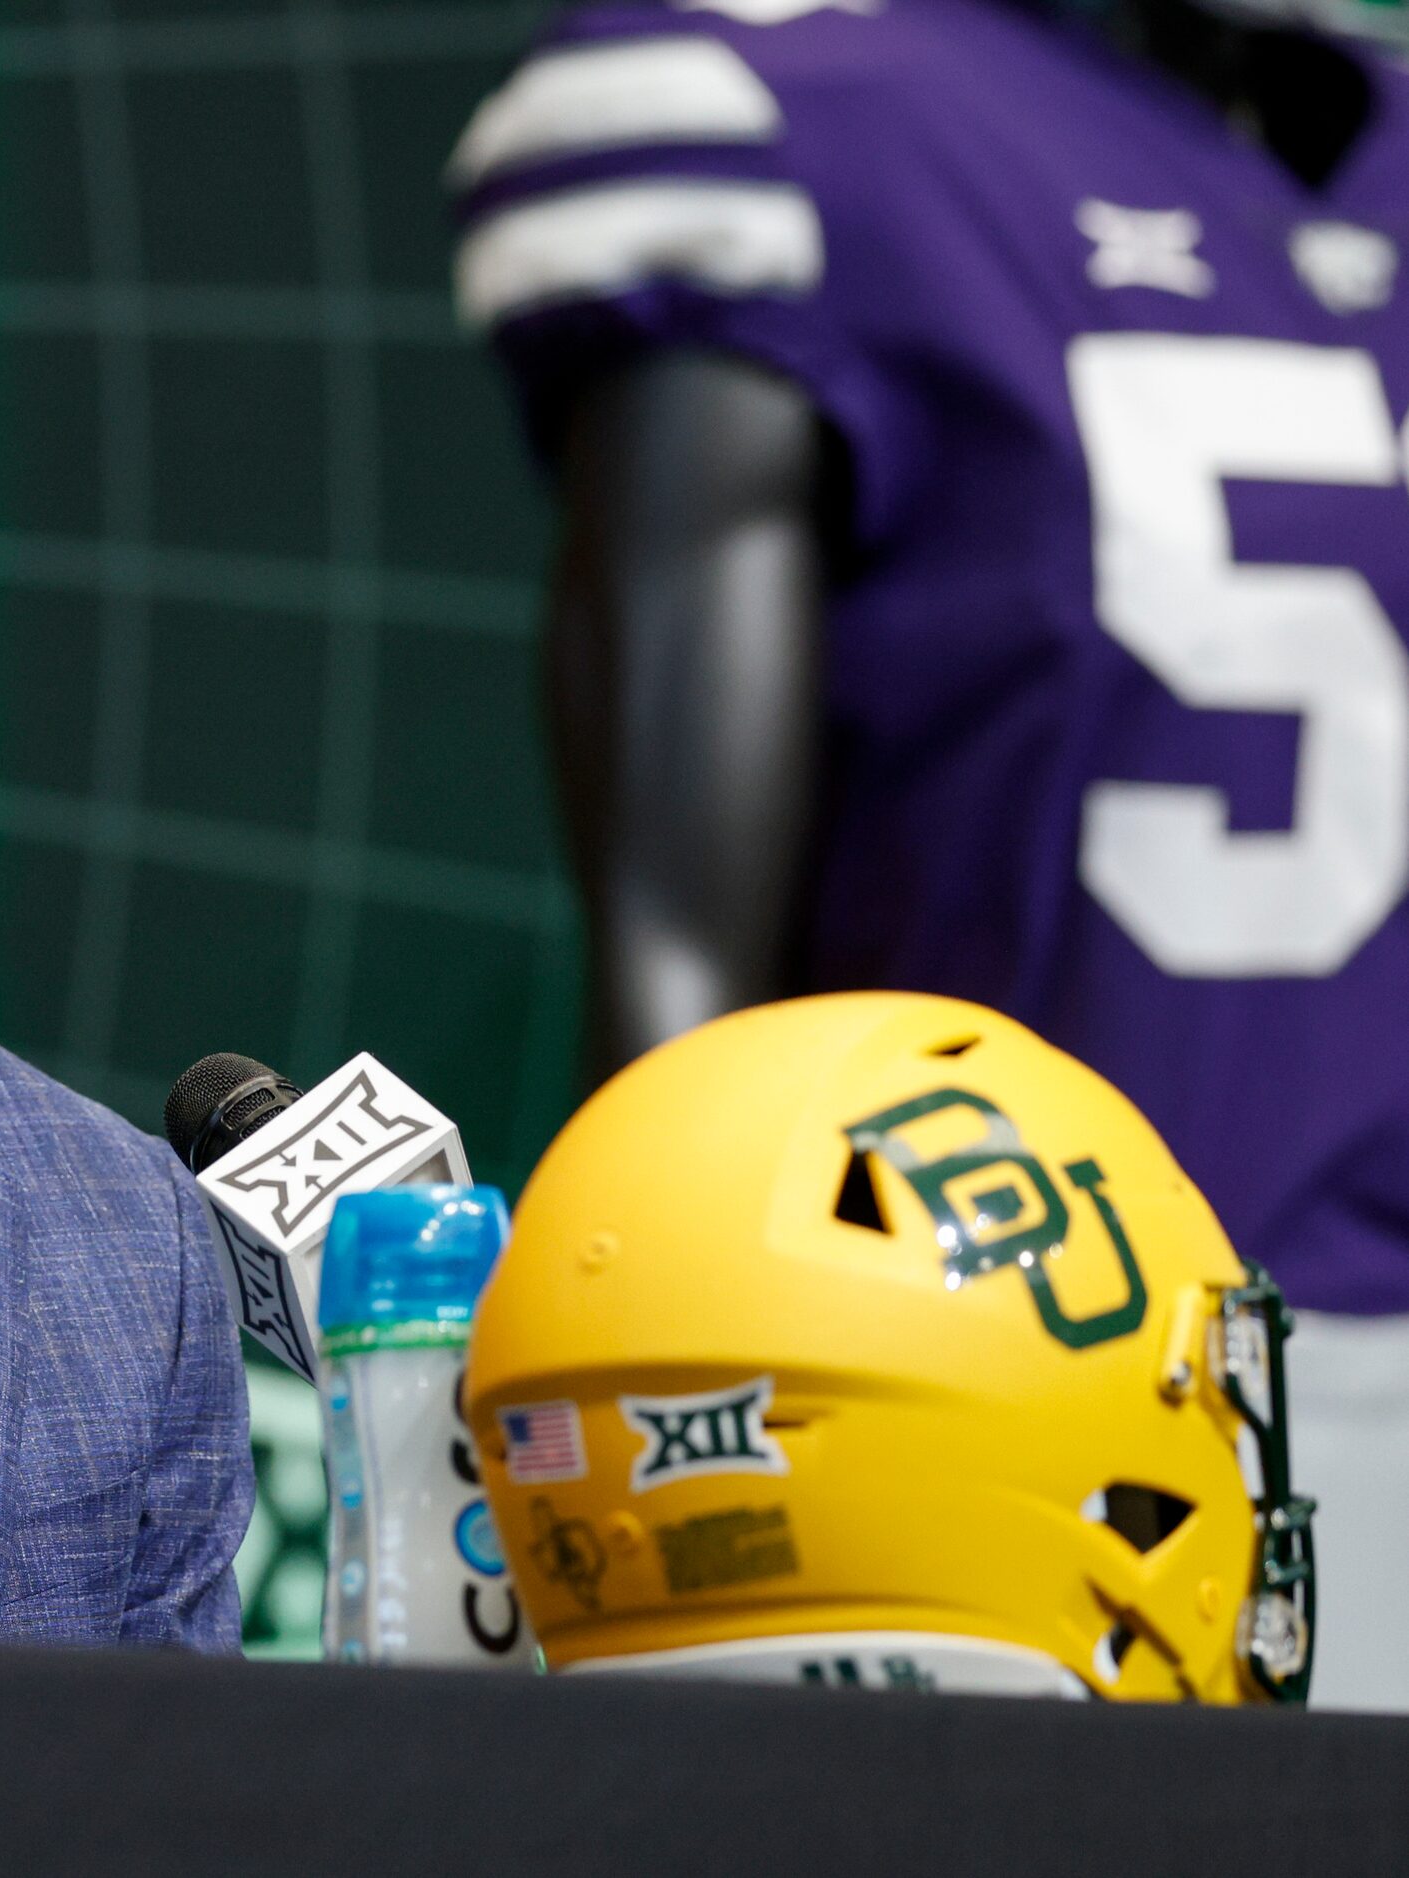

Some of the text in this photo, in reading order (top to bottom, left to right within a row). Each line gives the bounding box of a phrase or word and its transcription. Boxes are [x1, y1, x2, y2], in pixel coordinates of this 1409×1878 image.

[1065, 332, 1409, 979] 5
[841, 1088, 1149, 1351] BU
[634, 1389, 770, 1478] XII
